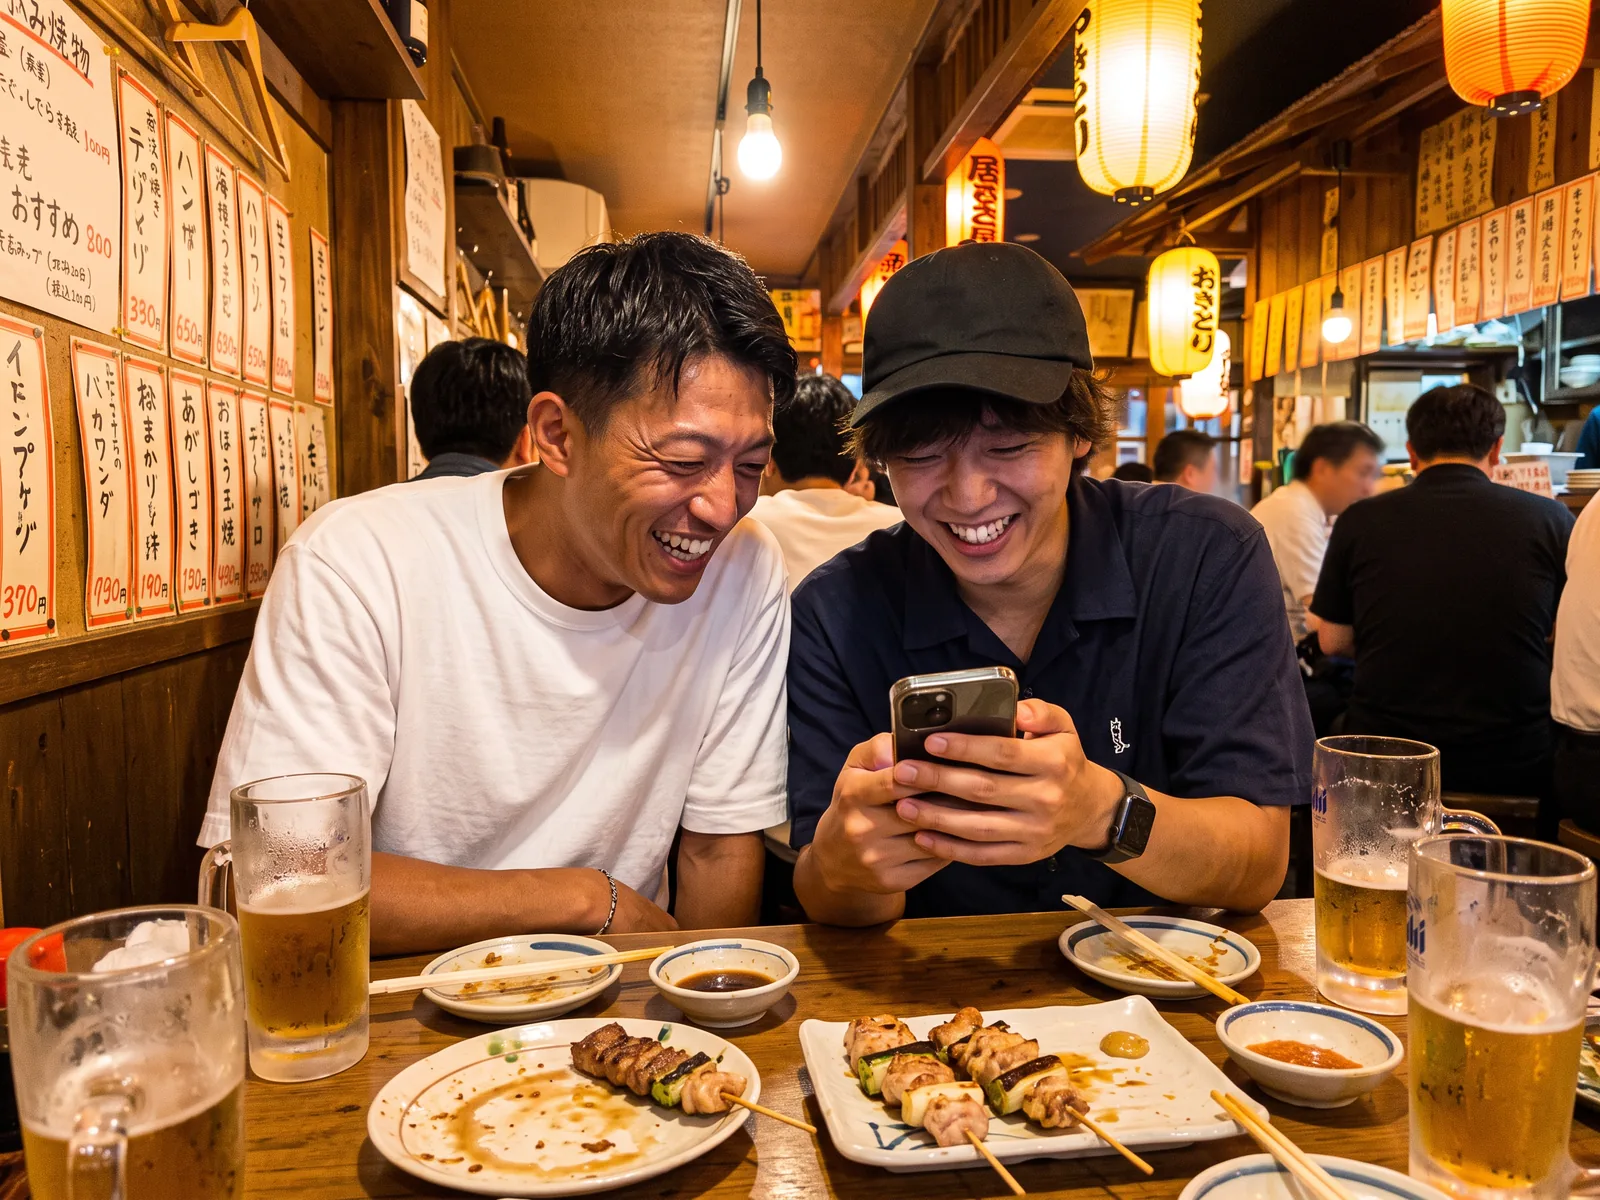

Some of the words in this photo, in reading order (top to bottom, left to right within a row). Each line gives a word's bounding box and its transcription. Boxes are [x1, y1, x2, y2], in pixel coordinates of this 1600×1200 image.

[11, 184, 79, 245] おすすめ
[86, 224, 112, 259] 800
[3, 584, 47, 619] 370円
